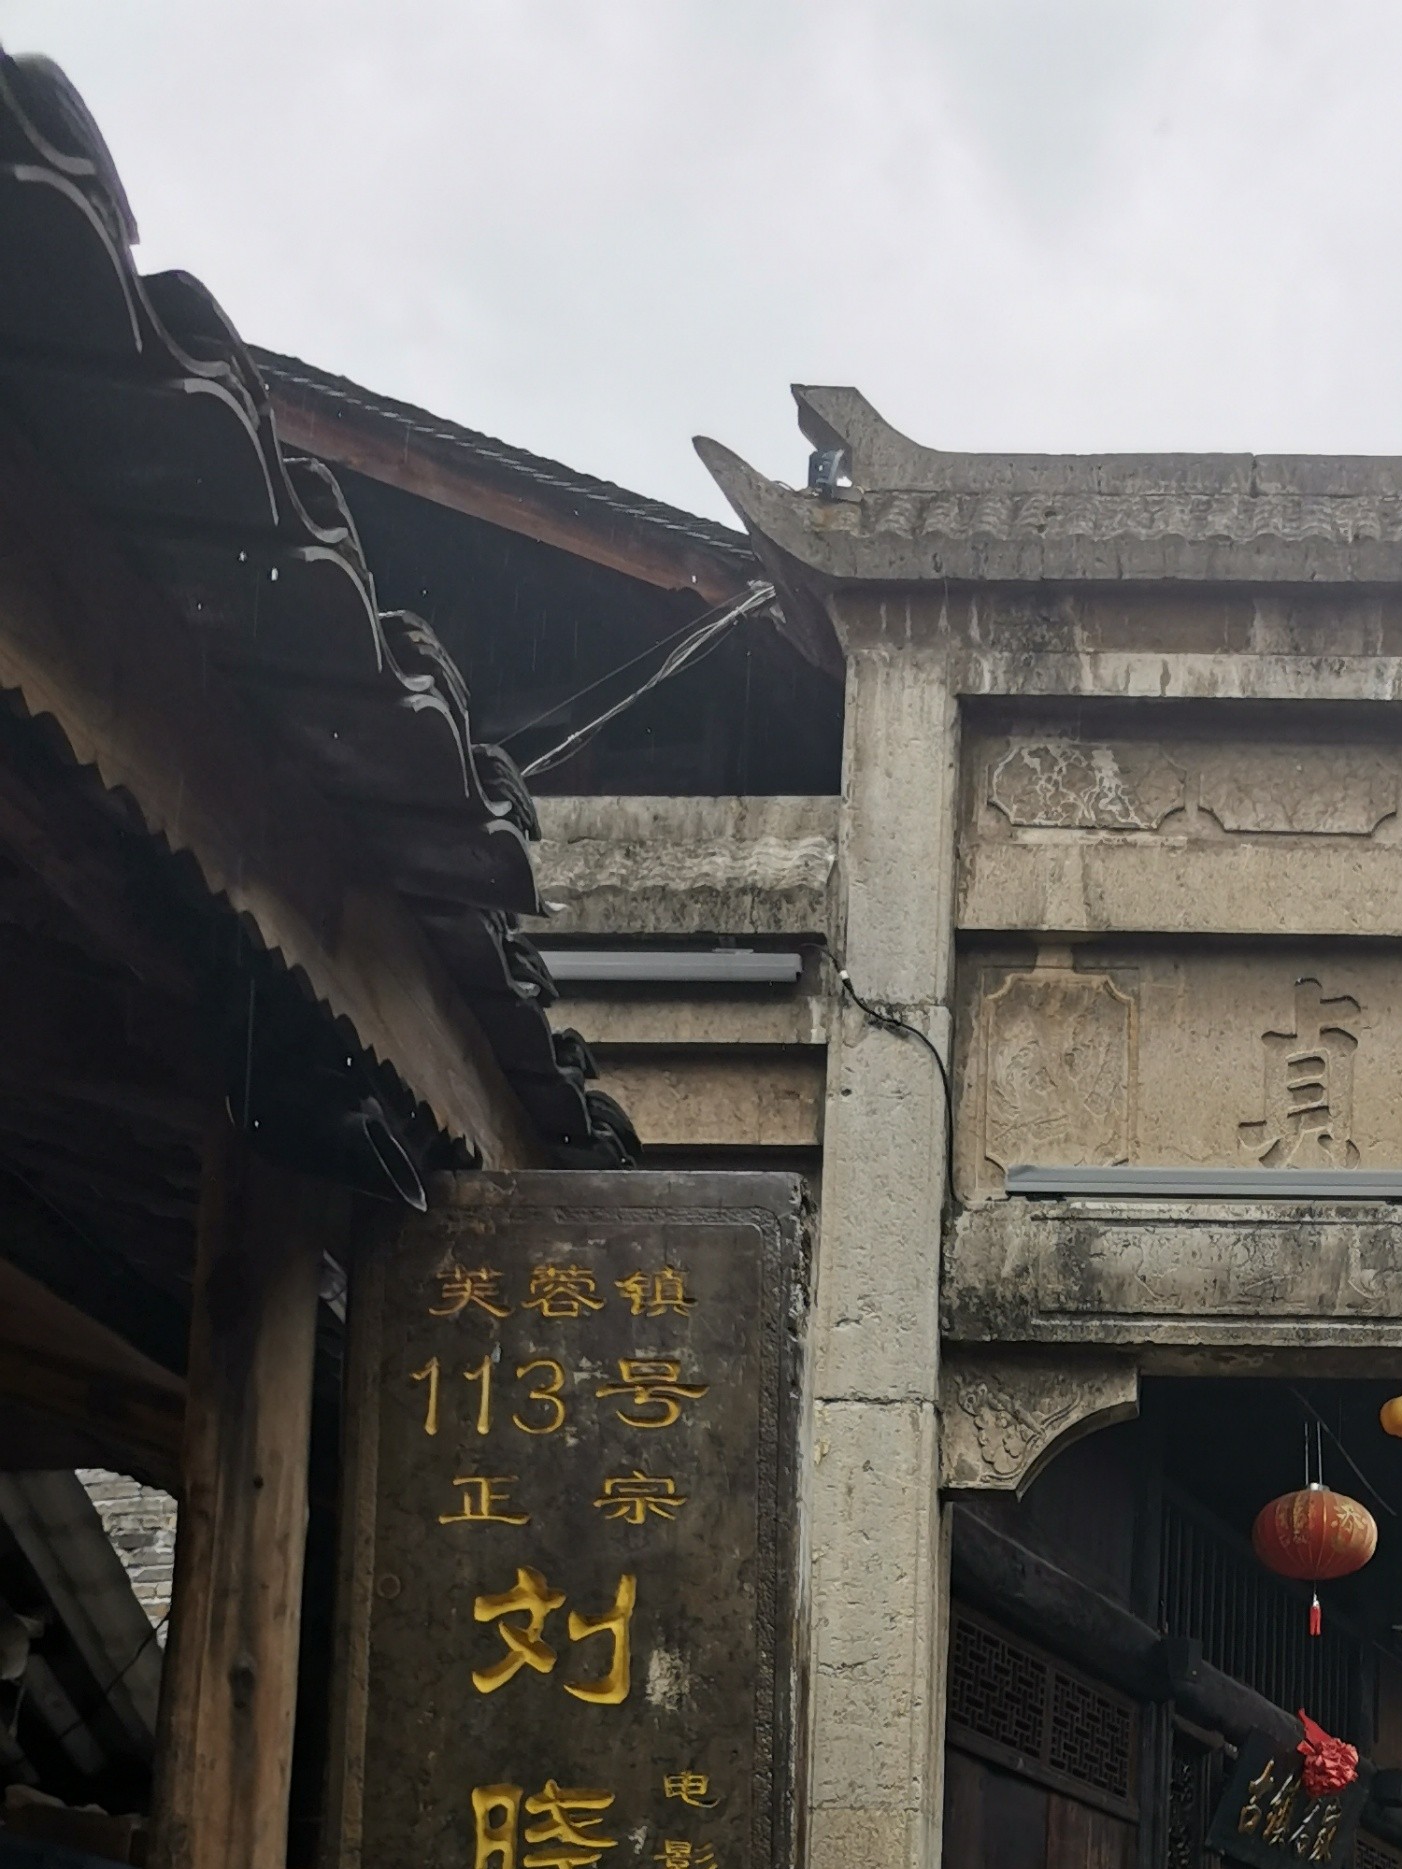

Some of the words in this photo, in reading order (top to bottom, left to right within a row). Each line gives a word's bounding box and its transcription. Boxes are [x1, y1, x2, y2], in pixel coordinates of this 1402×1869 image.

[428, 1264, 699, 1318] 芙蓉镇
[408, 1354, 711, 1436] 113号
[438, 1470, 689, 1526] 正宗
